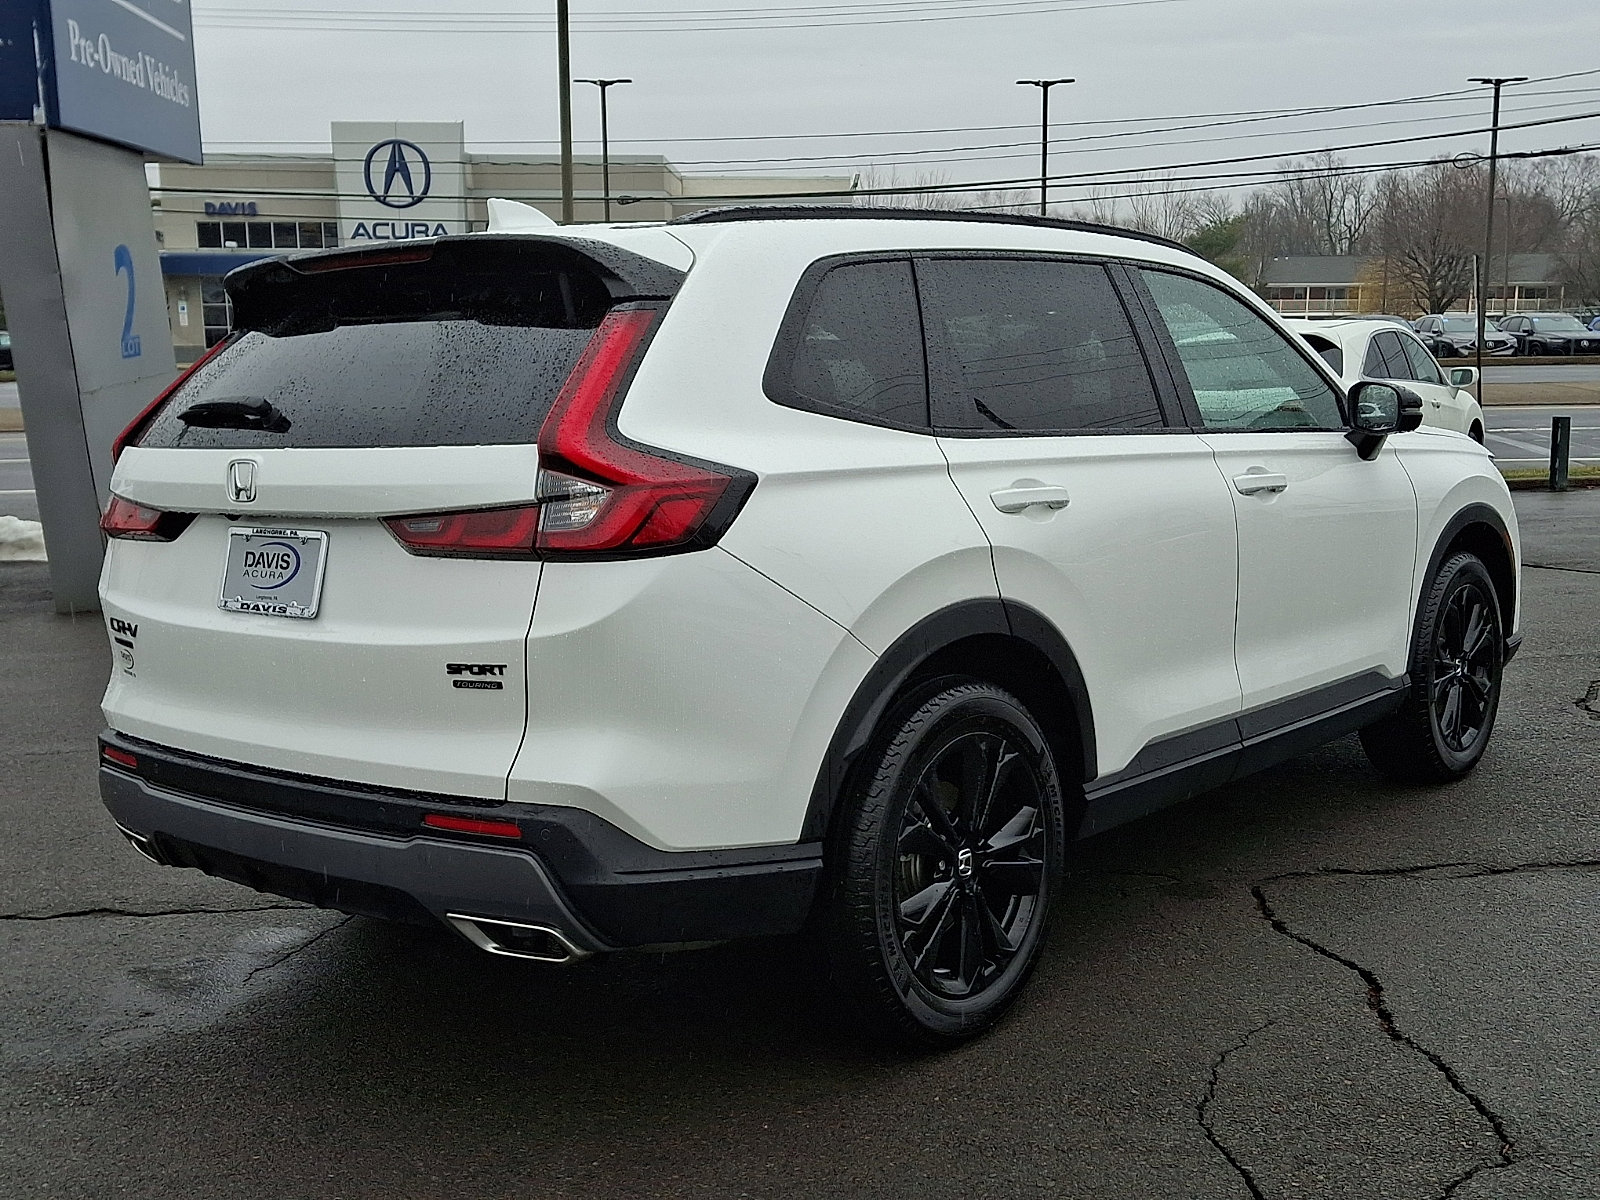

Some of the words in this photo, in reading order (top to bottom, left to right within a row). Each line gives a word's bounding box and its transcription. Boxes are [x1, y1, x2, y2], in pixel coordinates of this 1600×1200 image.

[67, 18, 144, 88] Pre-Owned
[144, 54, 190, 107] Vehicles
[204, 201, 257, 216] DAVIS
[350, 222, 449, 240] ACURA
[113, 244, 142, 358] 2
[122, 340, 141, 355] LOT
[244, 551, 291, 570] DAVIS
[243, 569, 284, 580] ACURA
[240, 602, 288, 614] DAVIS
[446, 663, 508, 676] SPORT
[455, 681, 498, 689] TOURING
[1048, 783, 1062, 865] MICHEL
